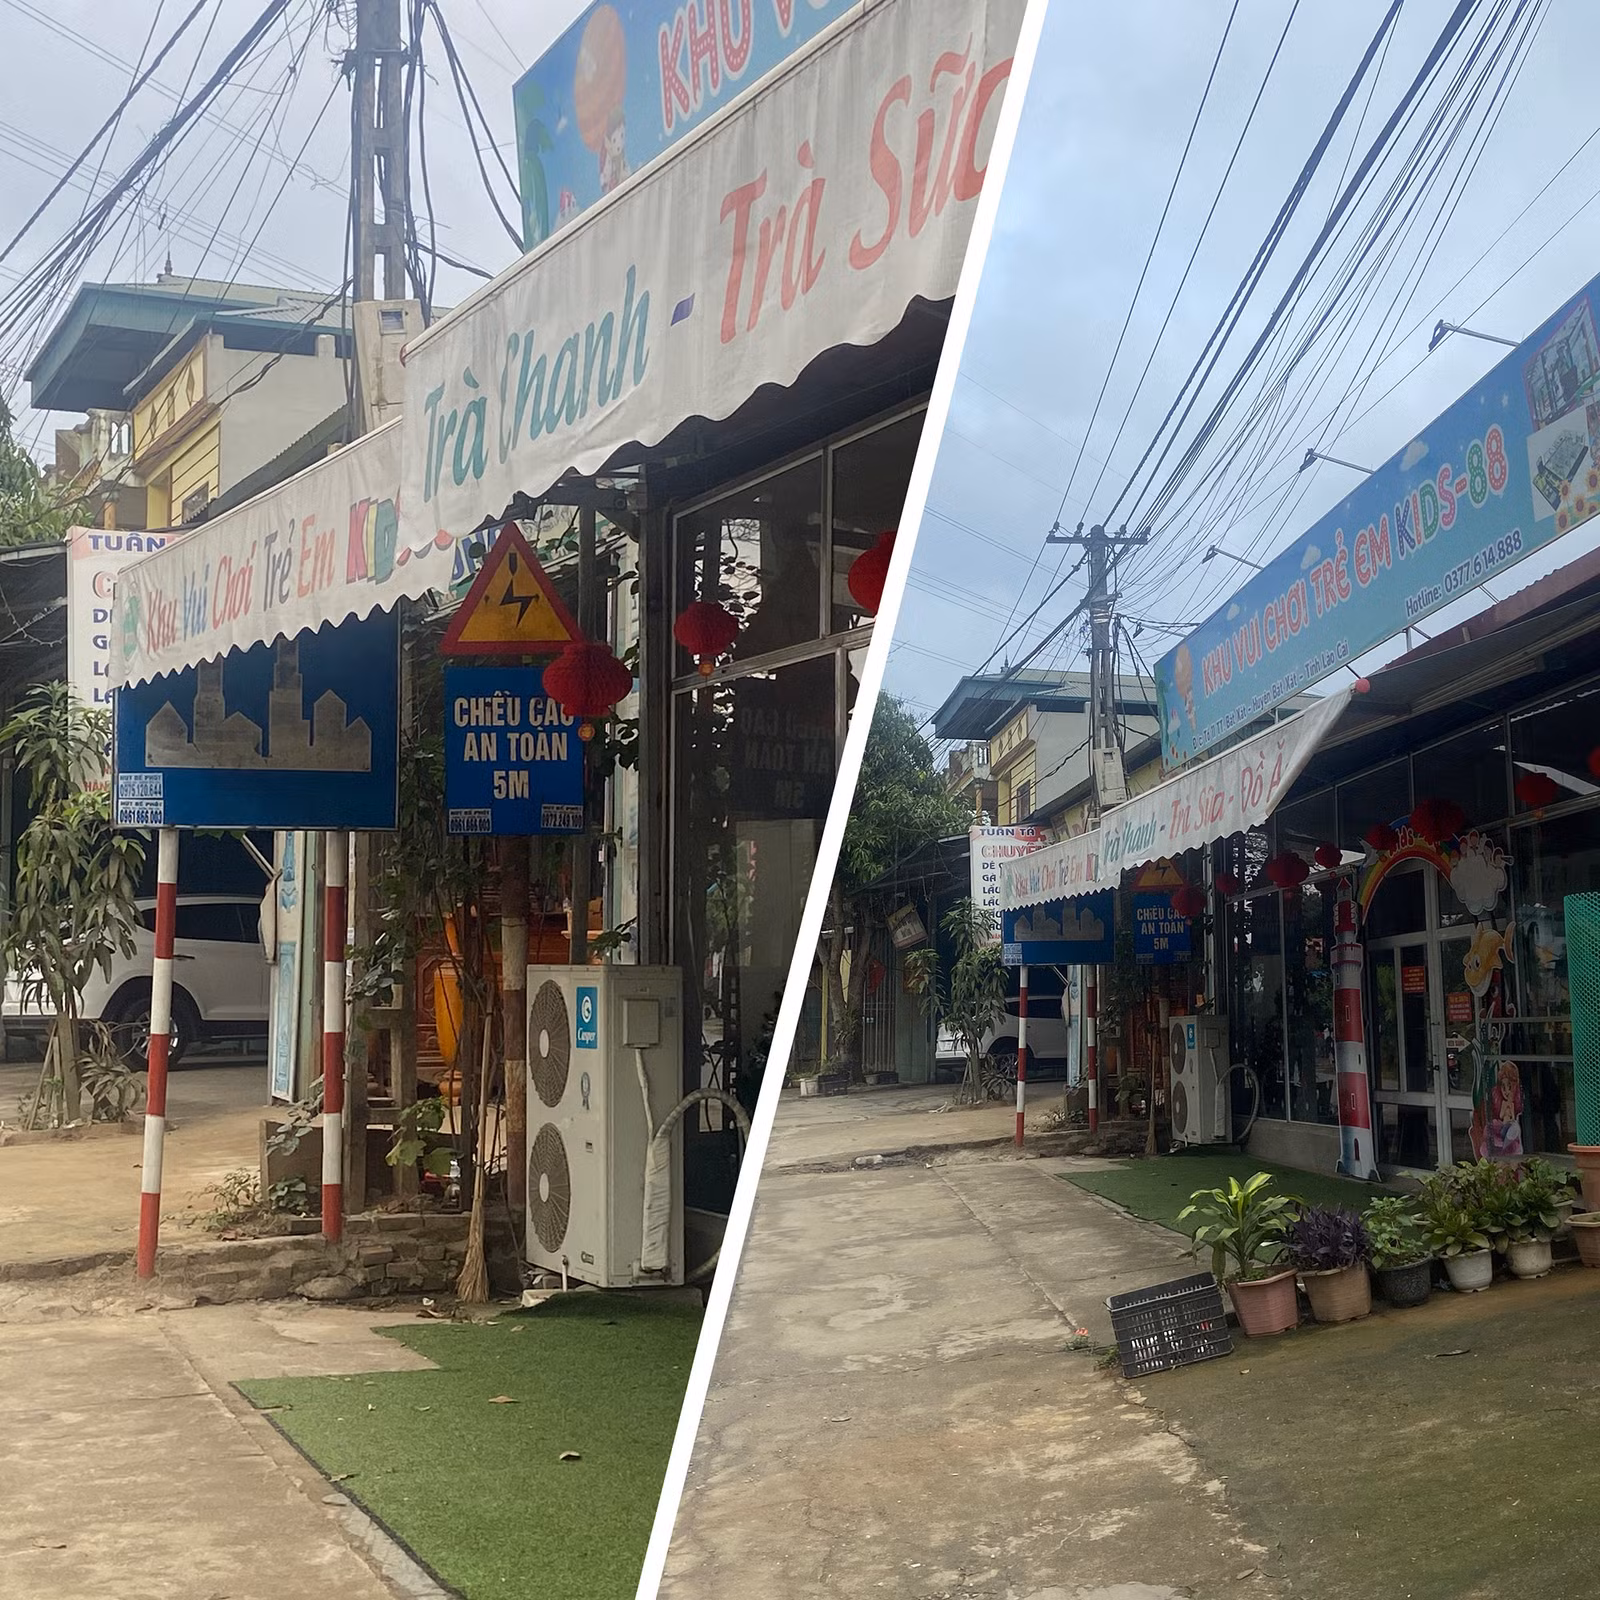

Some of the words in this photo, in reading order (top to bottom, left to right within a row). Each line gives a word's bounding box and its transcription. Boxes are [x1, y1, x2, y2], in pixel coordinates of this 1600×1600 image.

[424, 366, 489, 503] Trà
[499, 264, 650, 464] Chanh
[719, 140, 827, 346] Trà
[1202, 638, 1232, 696] KHU
[1233, 616, 1262, 671] VUI
[1264, 579, 1309, 652] CHƠI
[1355, 515, 1392, 586] EM
[1395, 426, 1508, 558] KIDS-88
[1406, 587, 1442, 617] Hotline:
[1443, 529, 1522, 595] 0377.614.888
[147, 588, 178, 655] Khu
[183, 563, 210, 641] Vui
[263, 518, 295, 612] Trẻ
[297, 514, 335, 598] Em
[454, 690, 521, 727] CHIỀU
[463, 732, 497, 762] AN
[507, 727, 568, 762] TOÀN
[493, 770, 529, 800] 5M
[1141, 922, 1156, 935] AN
[1153, 937, 1169, 950] 5M
